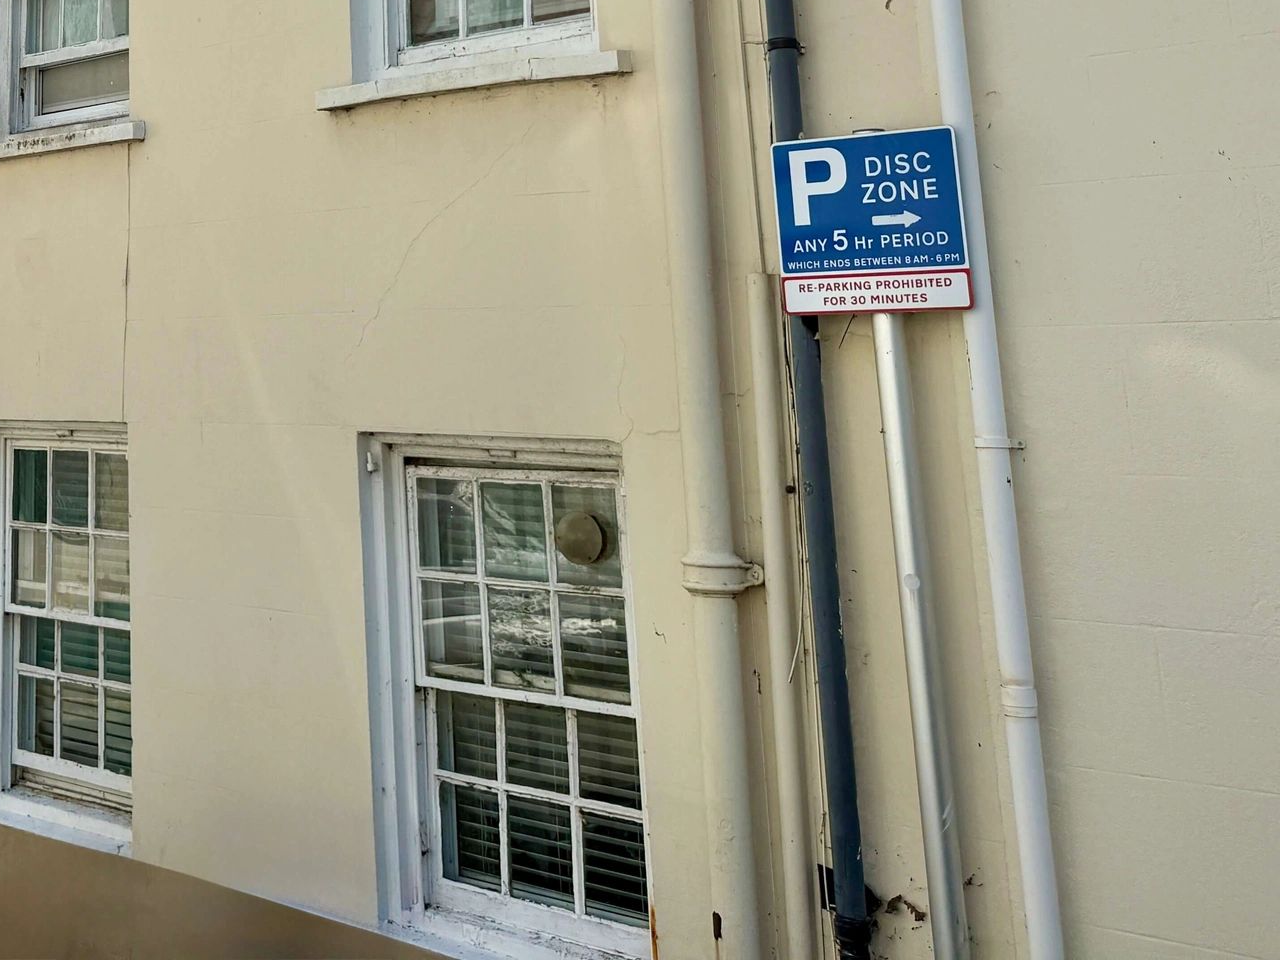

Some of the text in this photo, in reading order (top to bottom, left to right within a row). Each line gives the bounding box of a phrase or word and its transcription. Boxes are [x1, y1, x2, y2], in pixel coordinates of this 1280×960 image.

[864, 151, 931, 177] DISC
[788, 147, 847, 226] P
[861, 178, 939, 204] ZONE
[793, 229, 949, 253] ANY 5 Hr PERIOD
[787, 260, 821, 270] WHICH
[823, 258, 851, 268] ENDS
[854, 256, 901, 267] BETWEEN
[798, 277, 952, 293] RE-PARKING PROHIBITED
[823, 293, 928, 306] FOR 30 MINUTES
